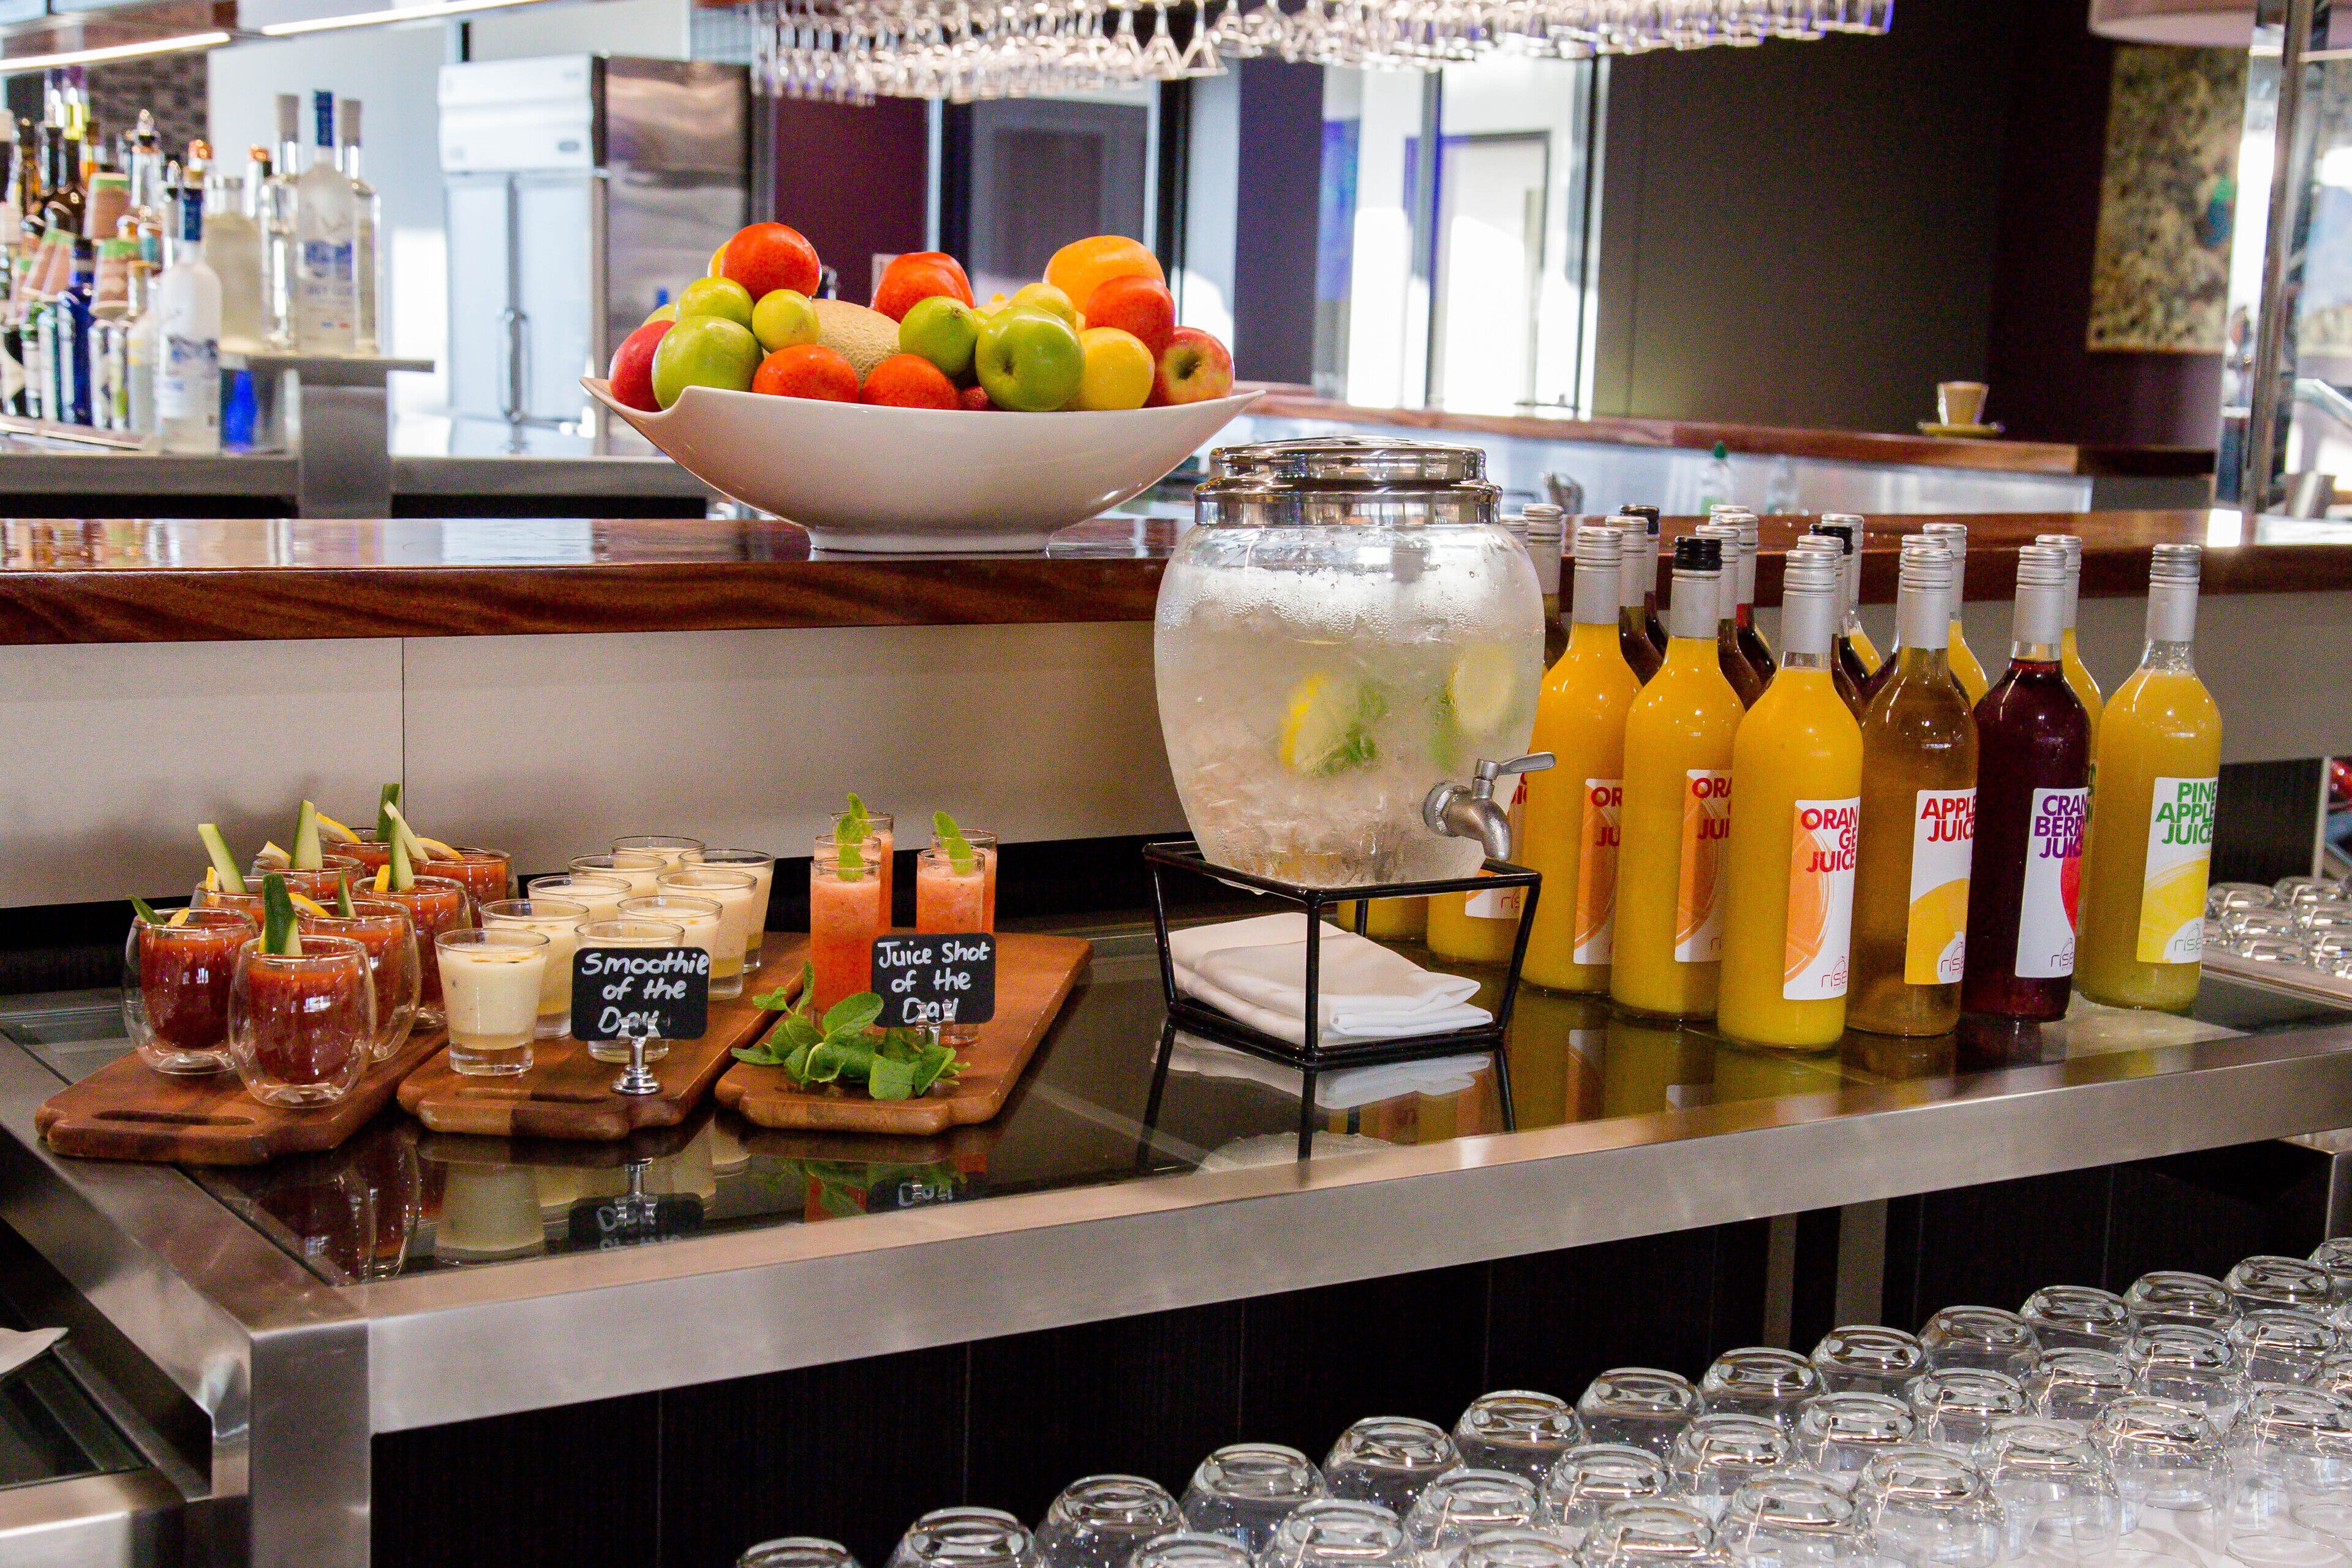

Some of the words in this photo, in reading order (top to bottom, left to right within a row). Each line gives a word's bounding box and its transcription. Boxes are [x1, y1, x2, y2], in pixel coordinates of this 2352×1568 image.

[2177, 780, 2217, 803] PINE
[1801, 805, 1858, 831] ORAN
[1920, 794, 1977, 820] APPLE
[2155, 802, 2214, 823] APPLE
[1839, 827, 1856, 850] GE
[1806, 848, 1855, 873] JUICE
[581, 950, 709, 975] Smoothie
[877, 941, 932, 968] Juice
[941, 940, 990, 963] Shot
[602, 976, 635, 1000] of
[643, 977, 687, 1000] the
[891, 969, 918, 993] of
[933, 967, 971, 991] the
